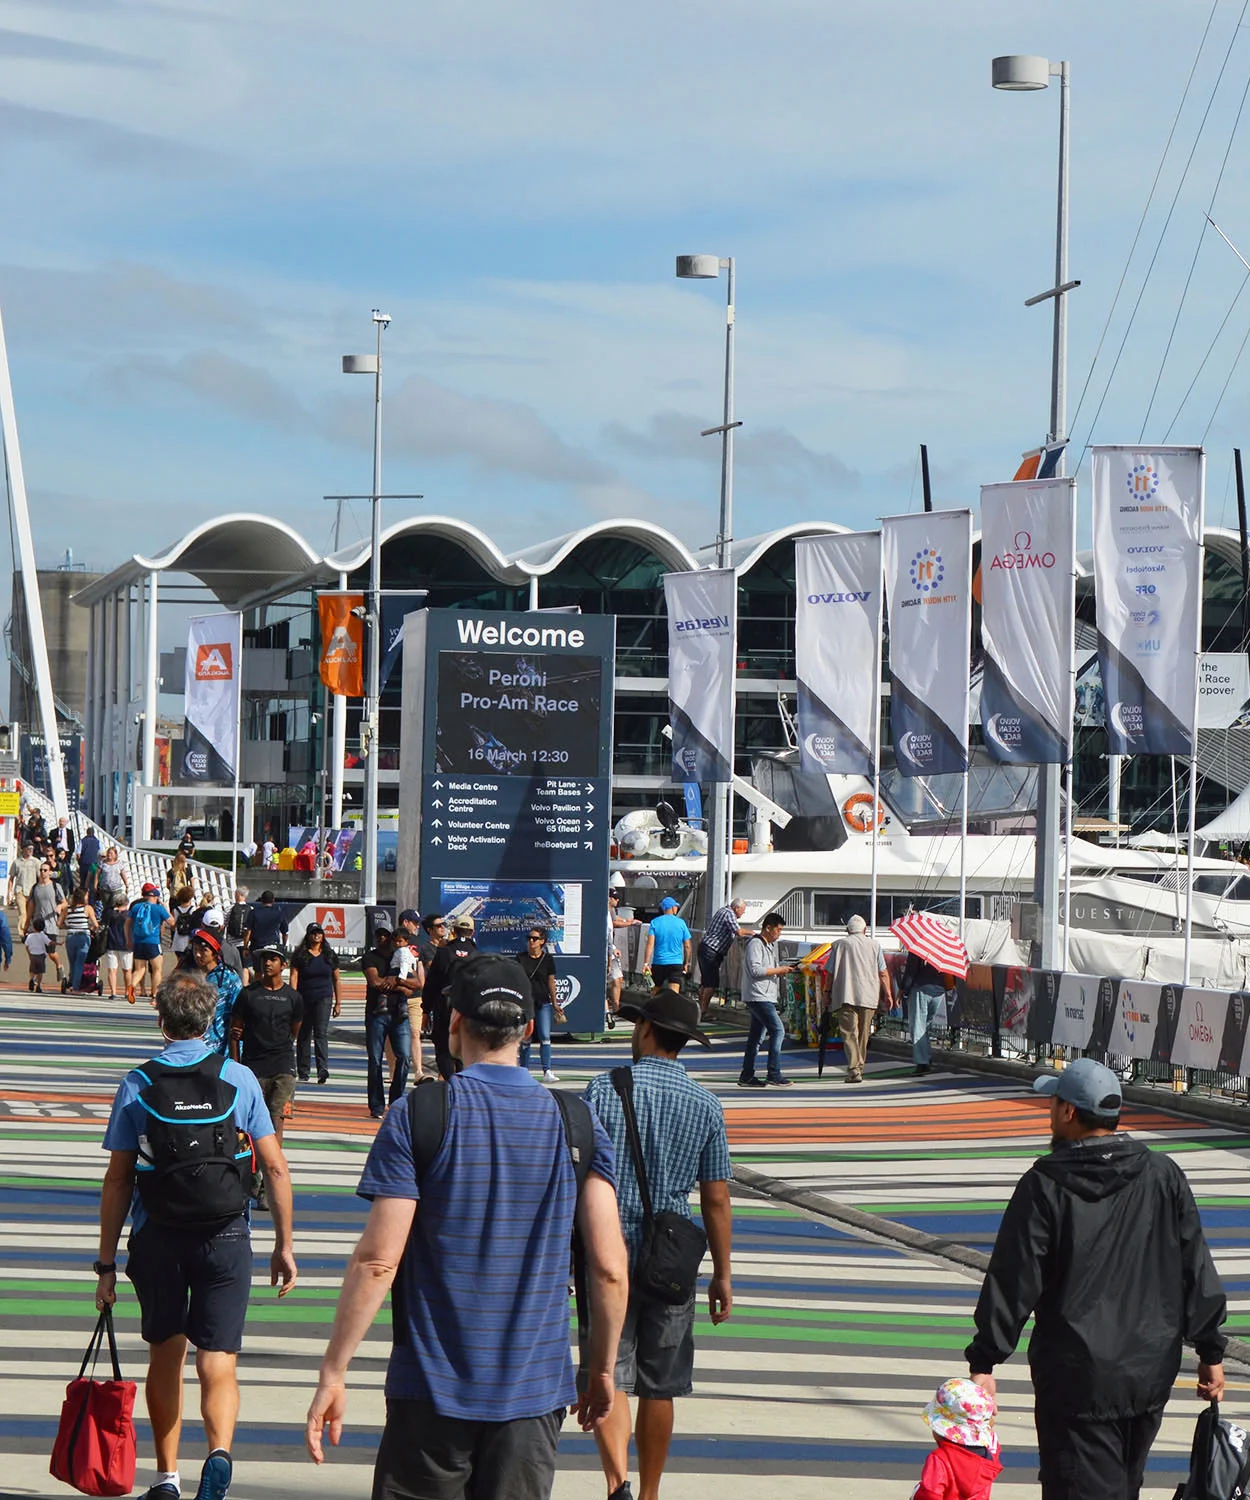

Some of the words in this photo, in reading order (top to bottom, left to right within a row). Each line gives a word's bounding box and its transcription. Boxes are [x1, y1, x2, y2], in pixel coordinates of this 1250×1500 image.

[457, 619, 585, 648] Welcome
[1202, 662, 1218, 672] the
[489, 669, 547, 687] Peroni
[1205, 674, 1230, 684] Race
[460, 692, 528, 711] Pro-Am
[534, 695, 579, 712] Race
[468, 749, 484, 760] 16
[487, 750, 527, 762] March
[532, 750, 569, 763] 12:30
[449, 782, 471, 790] Media
[473, 783, 498, 791] Centre
[448, 797, 497, 805] Accreditation
[448, 821, 483, 829] Volunteer
[485, 822, 510, 830] Centre
[448, 835, 468, 843] Volvo
[469, 836, 506, 844] Activation
[534, 841, 578, 850] theBoatyard
[1189, 1023, 1214, 1043] OMEGA
